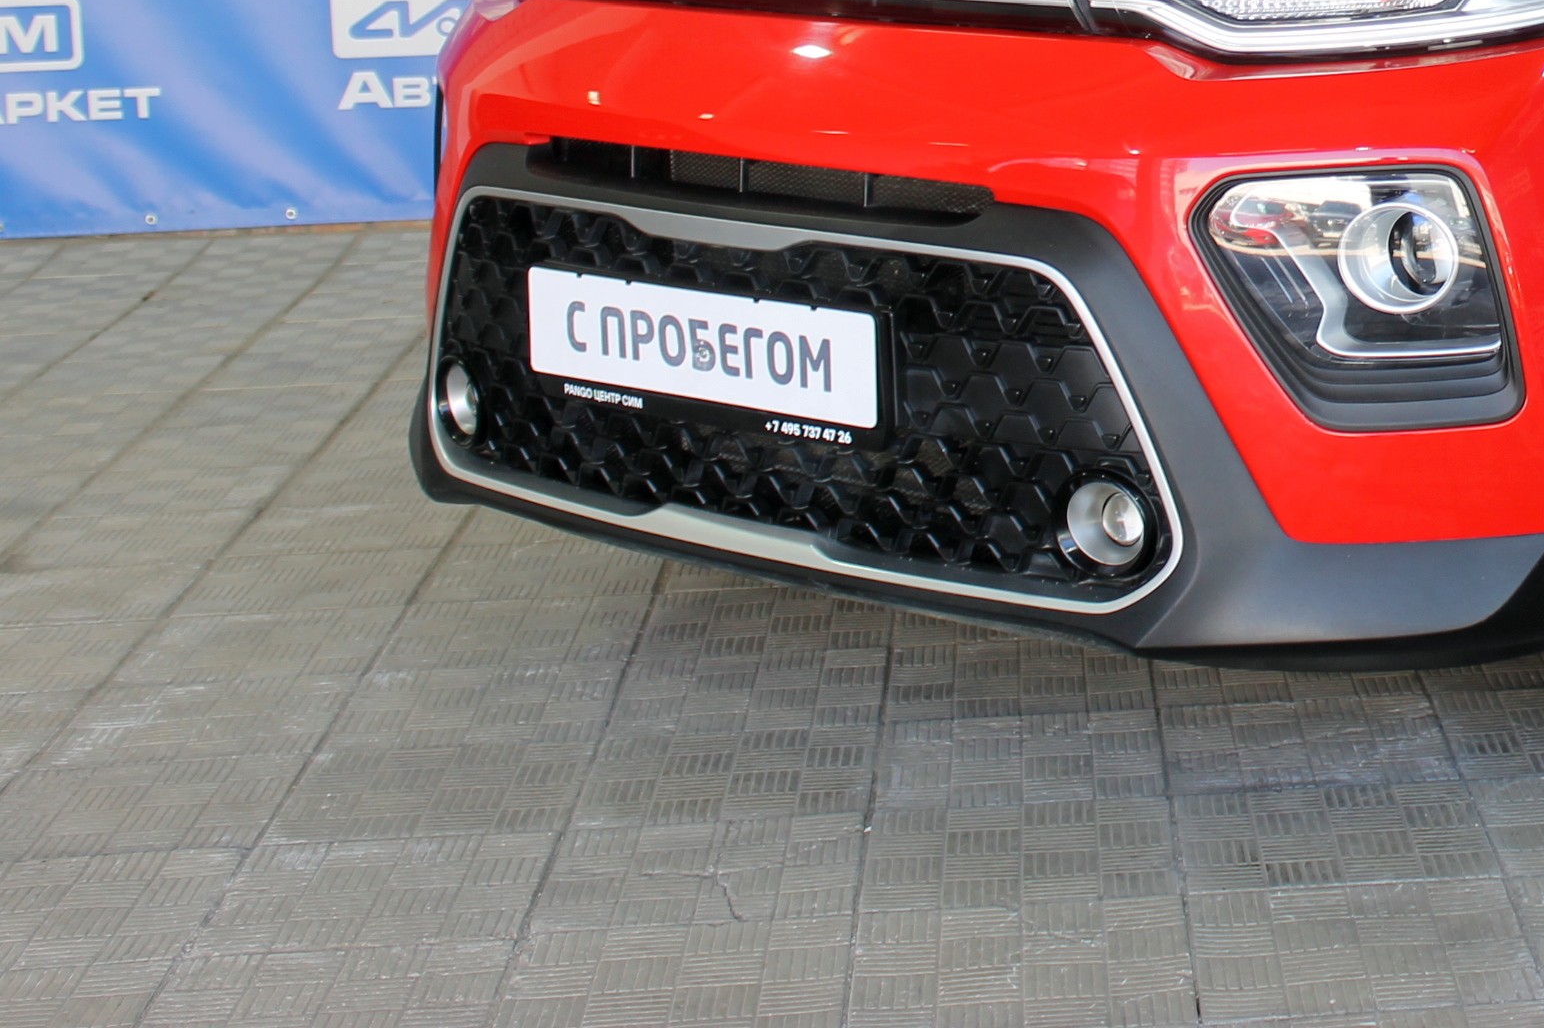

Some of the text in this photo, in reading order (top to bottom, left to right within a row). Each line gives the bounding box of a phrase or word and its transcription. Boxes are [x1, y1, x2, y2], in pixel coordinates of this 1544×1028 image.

[566, 301, 832, 393] С ПРОБЕГОМ
[564, 383, 643, 409] PANGO ЦЕНТР СИМ
[765, 420, 853, 444] +7 495 737 47 26
